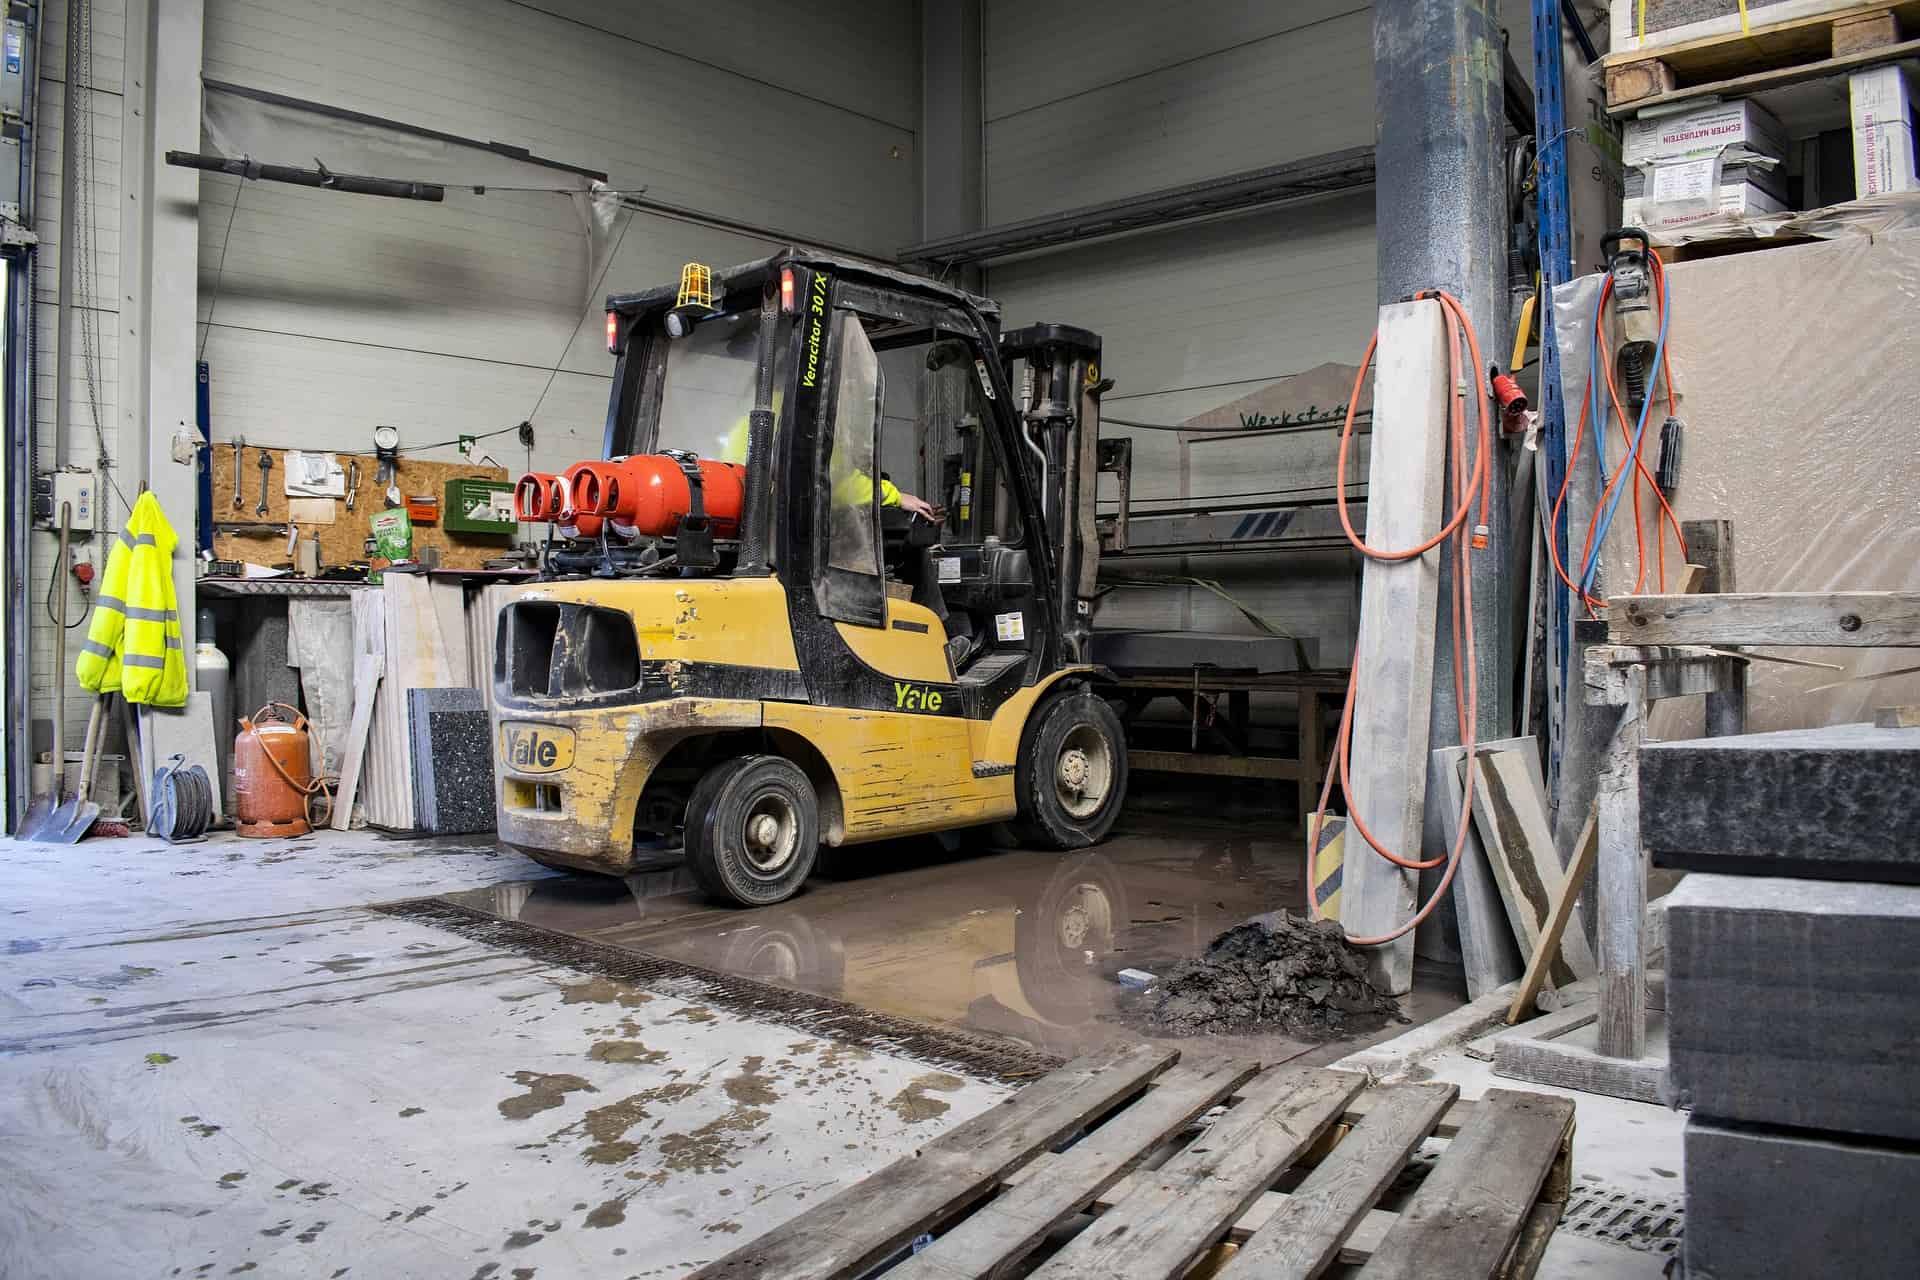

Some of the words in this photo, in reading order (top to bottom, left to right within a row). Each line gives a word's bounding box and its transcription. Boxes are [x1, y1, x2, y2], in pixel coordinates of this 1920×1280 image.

[1663, 129, 1709, 145] NATURSTEIN
[1711, 123, 1742, 136] ECHTER
[802, 318, 822, 388] Veracitor
[893, 681, 943, 712] Yale
[504, 727, 558, 768] Yale
